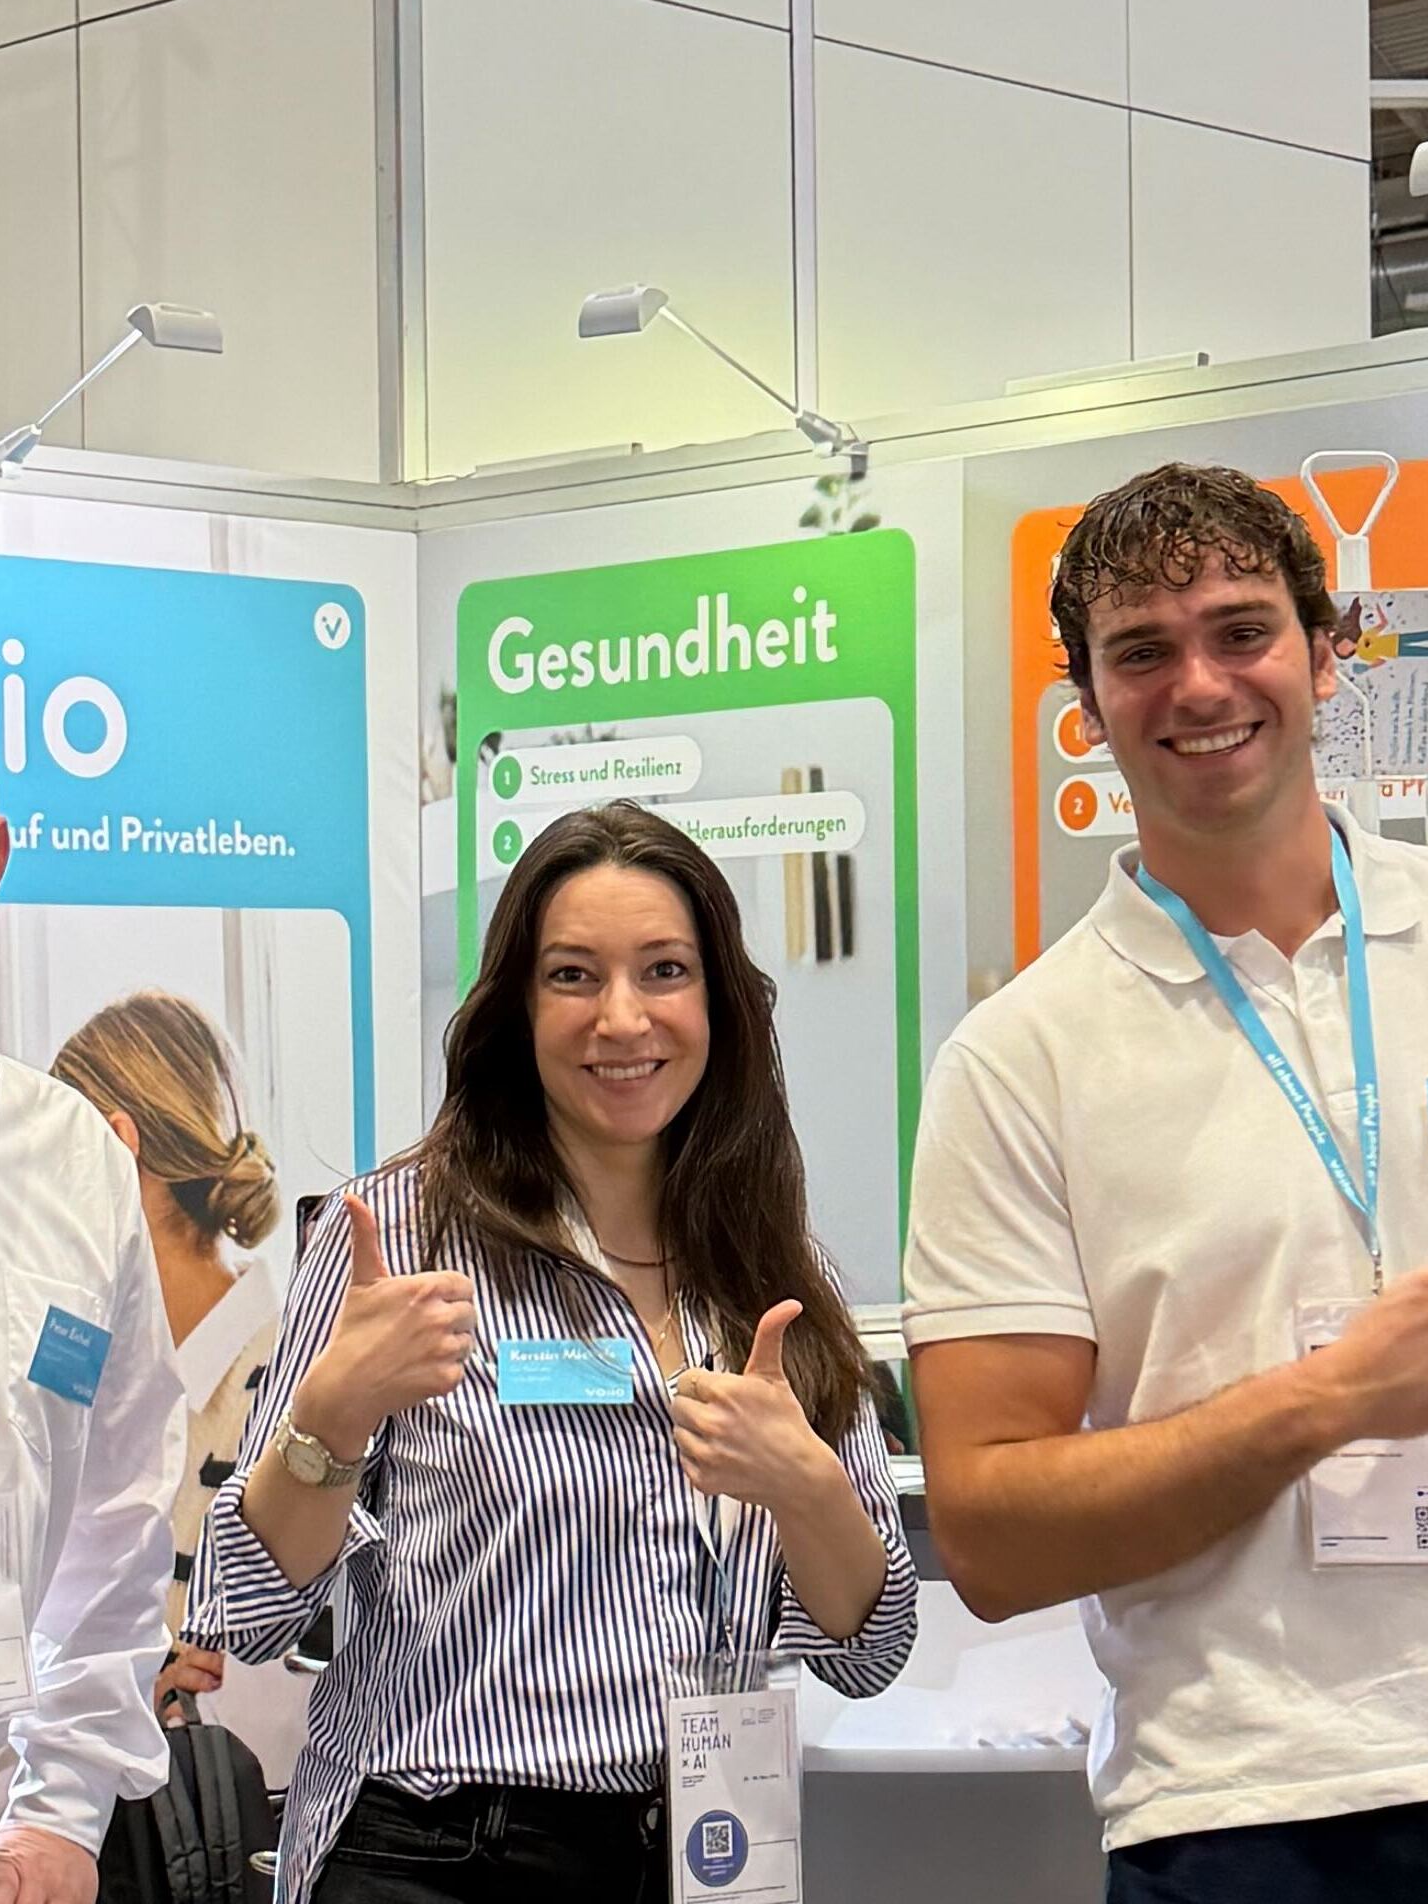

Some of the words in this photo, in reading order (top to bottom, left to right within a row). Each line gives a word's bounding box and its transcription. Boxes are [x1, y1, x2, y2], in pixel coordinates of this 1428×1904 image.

[488, 585, 838, 694] Gesundheit
[504, 771, 511, 785] 1
[531, 765, 575, 786] Stress
[579, 759, 609, 782] und
[614, 757, 682, 780] Resilienz
[1074, 798, 1084, 815] 2
[52, 815, 110, 851] und
[121, 816, 296, 856] Privatleben.
[503, 836, 512, 850] 2
[687, 815, 846, 842] Herausforderungen
[680, 1716, 719, 1734] TEAM
[681, 1733, 731, 1753] HUMAN
[693, 1754, 707, 1769] AI
